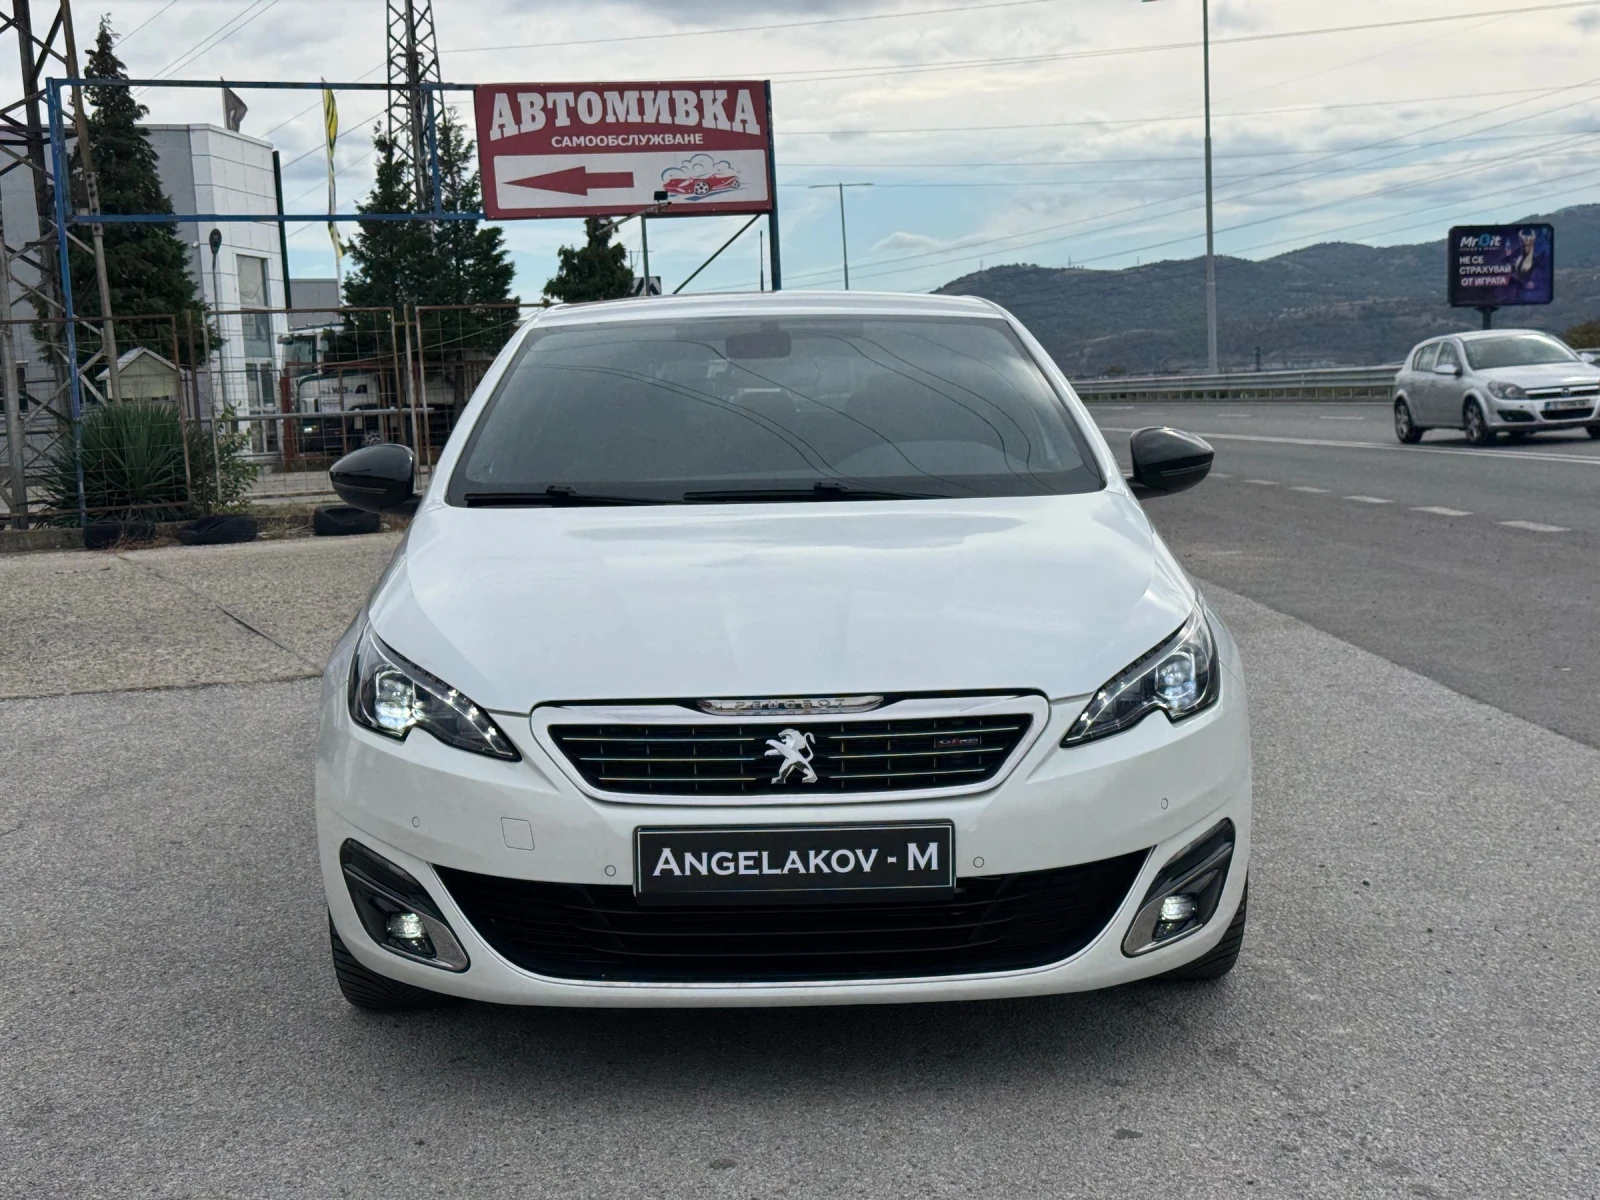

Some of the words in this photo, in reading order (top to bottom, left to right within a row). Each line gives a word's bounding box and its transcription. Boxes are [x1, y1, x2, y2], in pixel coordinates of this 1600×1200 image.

[489, 89, 761, 142] АВТОМИВКА
[551, 133, 704, 148] САМООБСЛУЖВАНЕ
[1459, 255, 1471, 265] НЕ
[1471, 255, 1485, 265] СЕ
[1459, 263, 1512, 275] СТРАХУВАЙ
[1461, 277, 1474, 287] ОТ
[1475, 275, 1507, 286] ИГРАТА
[652, 847, 879, 877] ANGELAKOV
[907, 842, 939, 871] M
